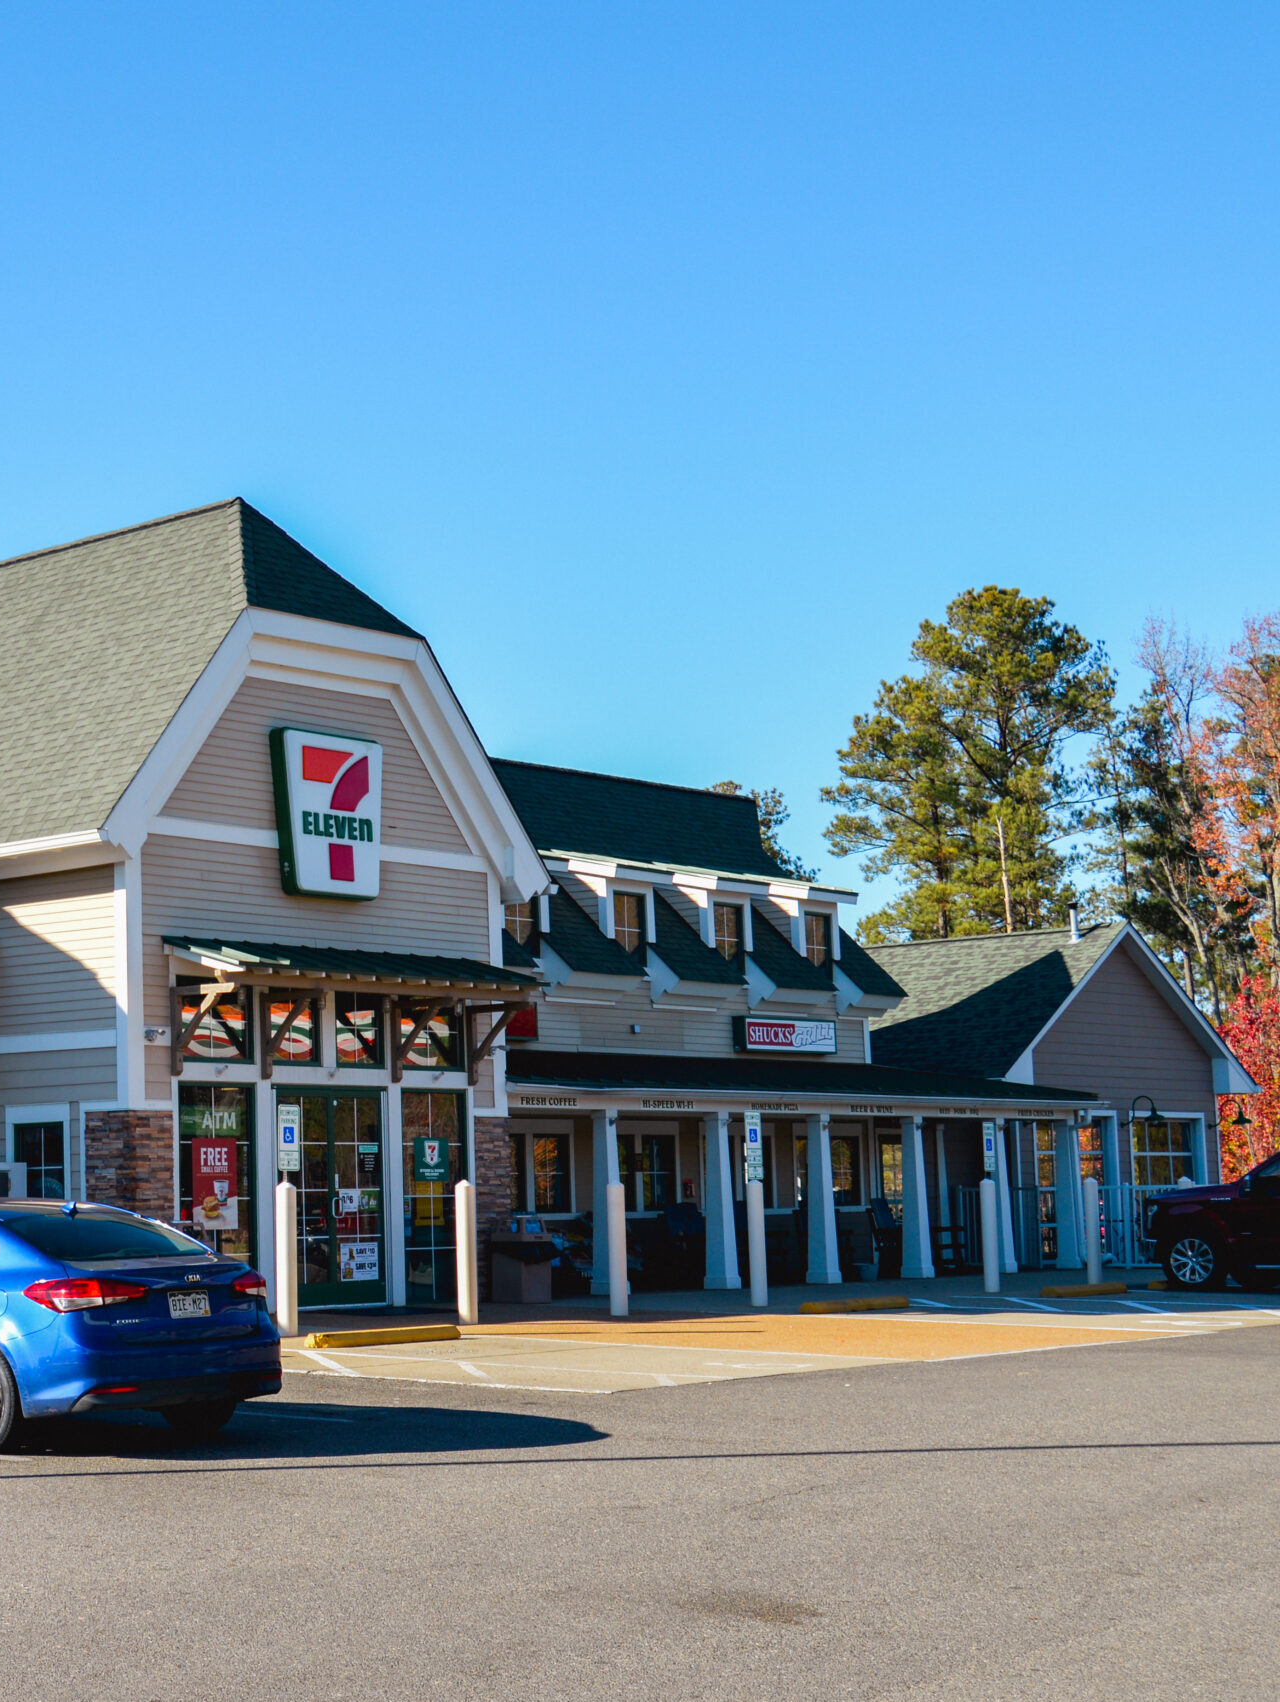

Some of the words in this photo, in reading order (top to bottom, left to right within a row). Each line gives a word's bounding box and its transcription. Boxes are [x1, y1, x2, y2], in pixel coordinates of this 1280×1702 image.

[749, 1026, 793, 1043] SHUCKS'
[792, 1024, 832, 1047] GRILL
[520, 1096, 547, 1106] FRESH
[548, 1097, 577, 1107] COFFEE
[642, 1100, 675, 1109] HI-SPEED
[676, 1101, 694, 1109] WI-FI
[751, 1103, 783, 1111] HOMEMADE
[783, 1103, 799, 1111] PIZZA
[850, 1104, 868, 1113] BEER
[876, 1105, 894, 1114] WINE
[202, 1111, 236, 1130] ATM
[200, 1147, 228, 1166] FREE
